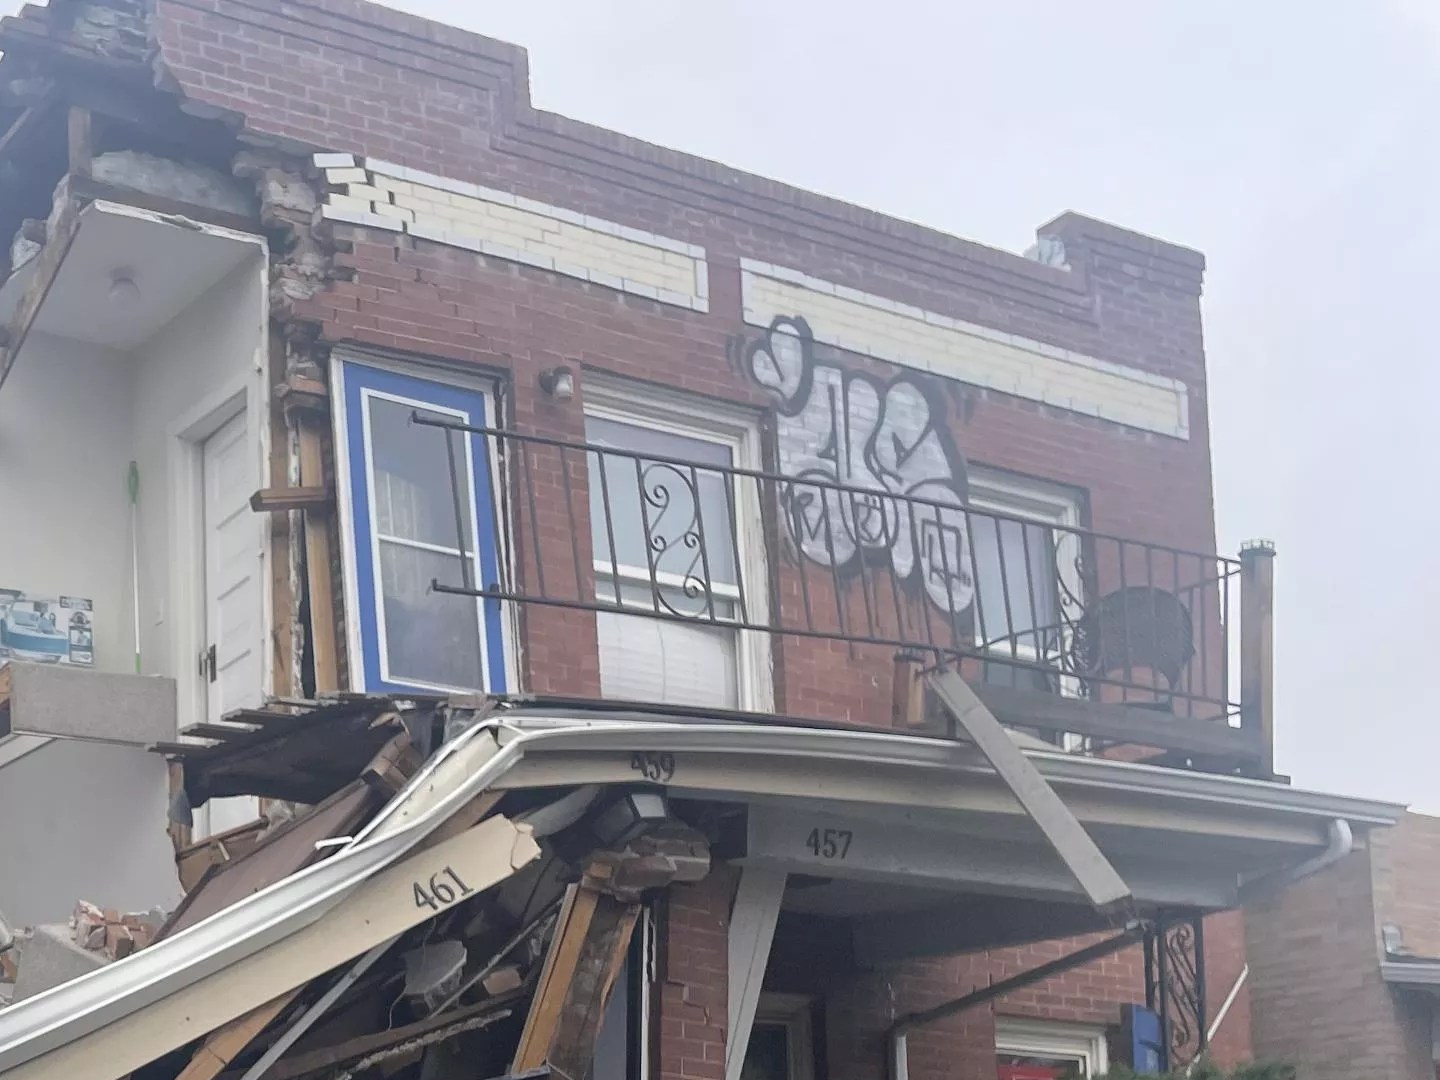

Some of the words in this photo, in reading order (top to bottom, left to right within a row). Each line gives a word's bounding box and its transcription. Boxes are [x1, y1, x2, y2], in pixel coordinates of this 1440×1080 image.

[631, 750, 675, 782] 459
[806, 828, 853, 859] 457
[412, 866, 474, 912] 461
